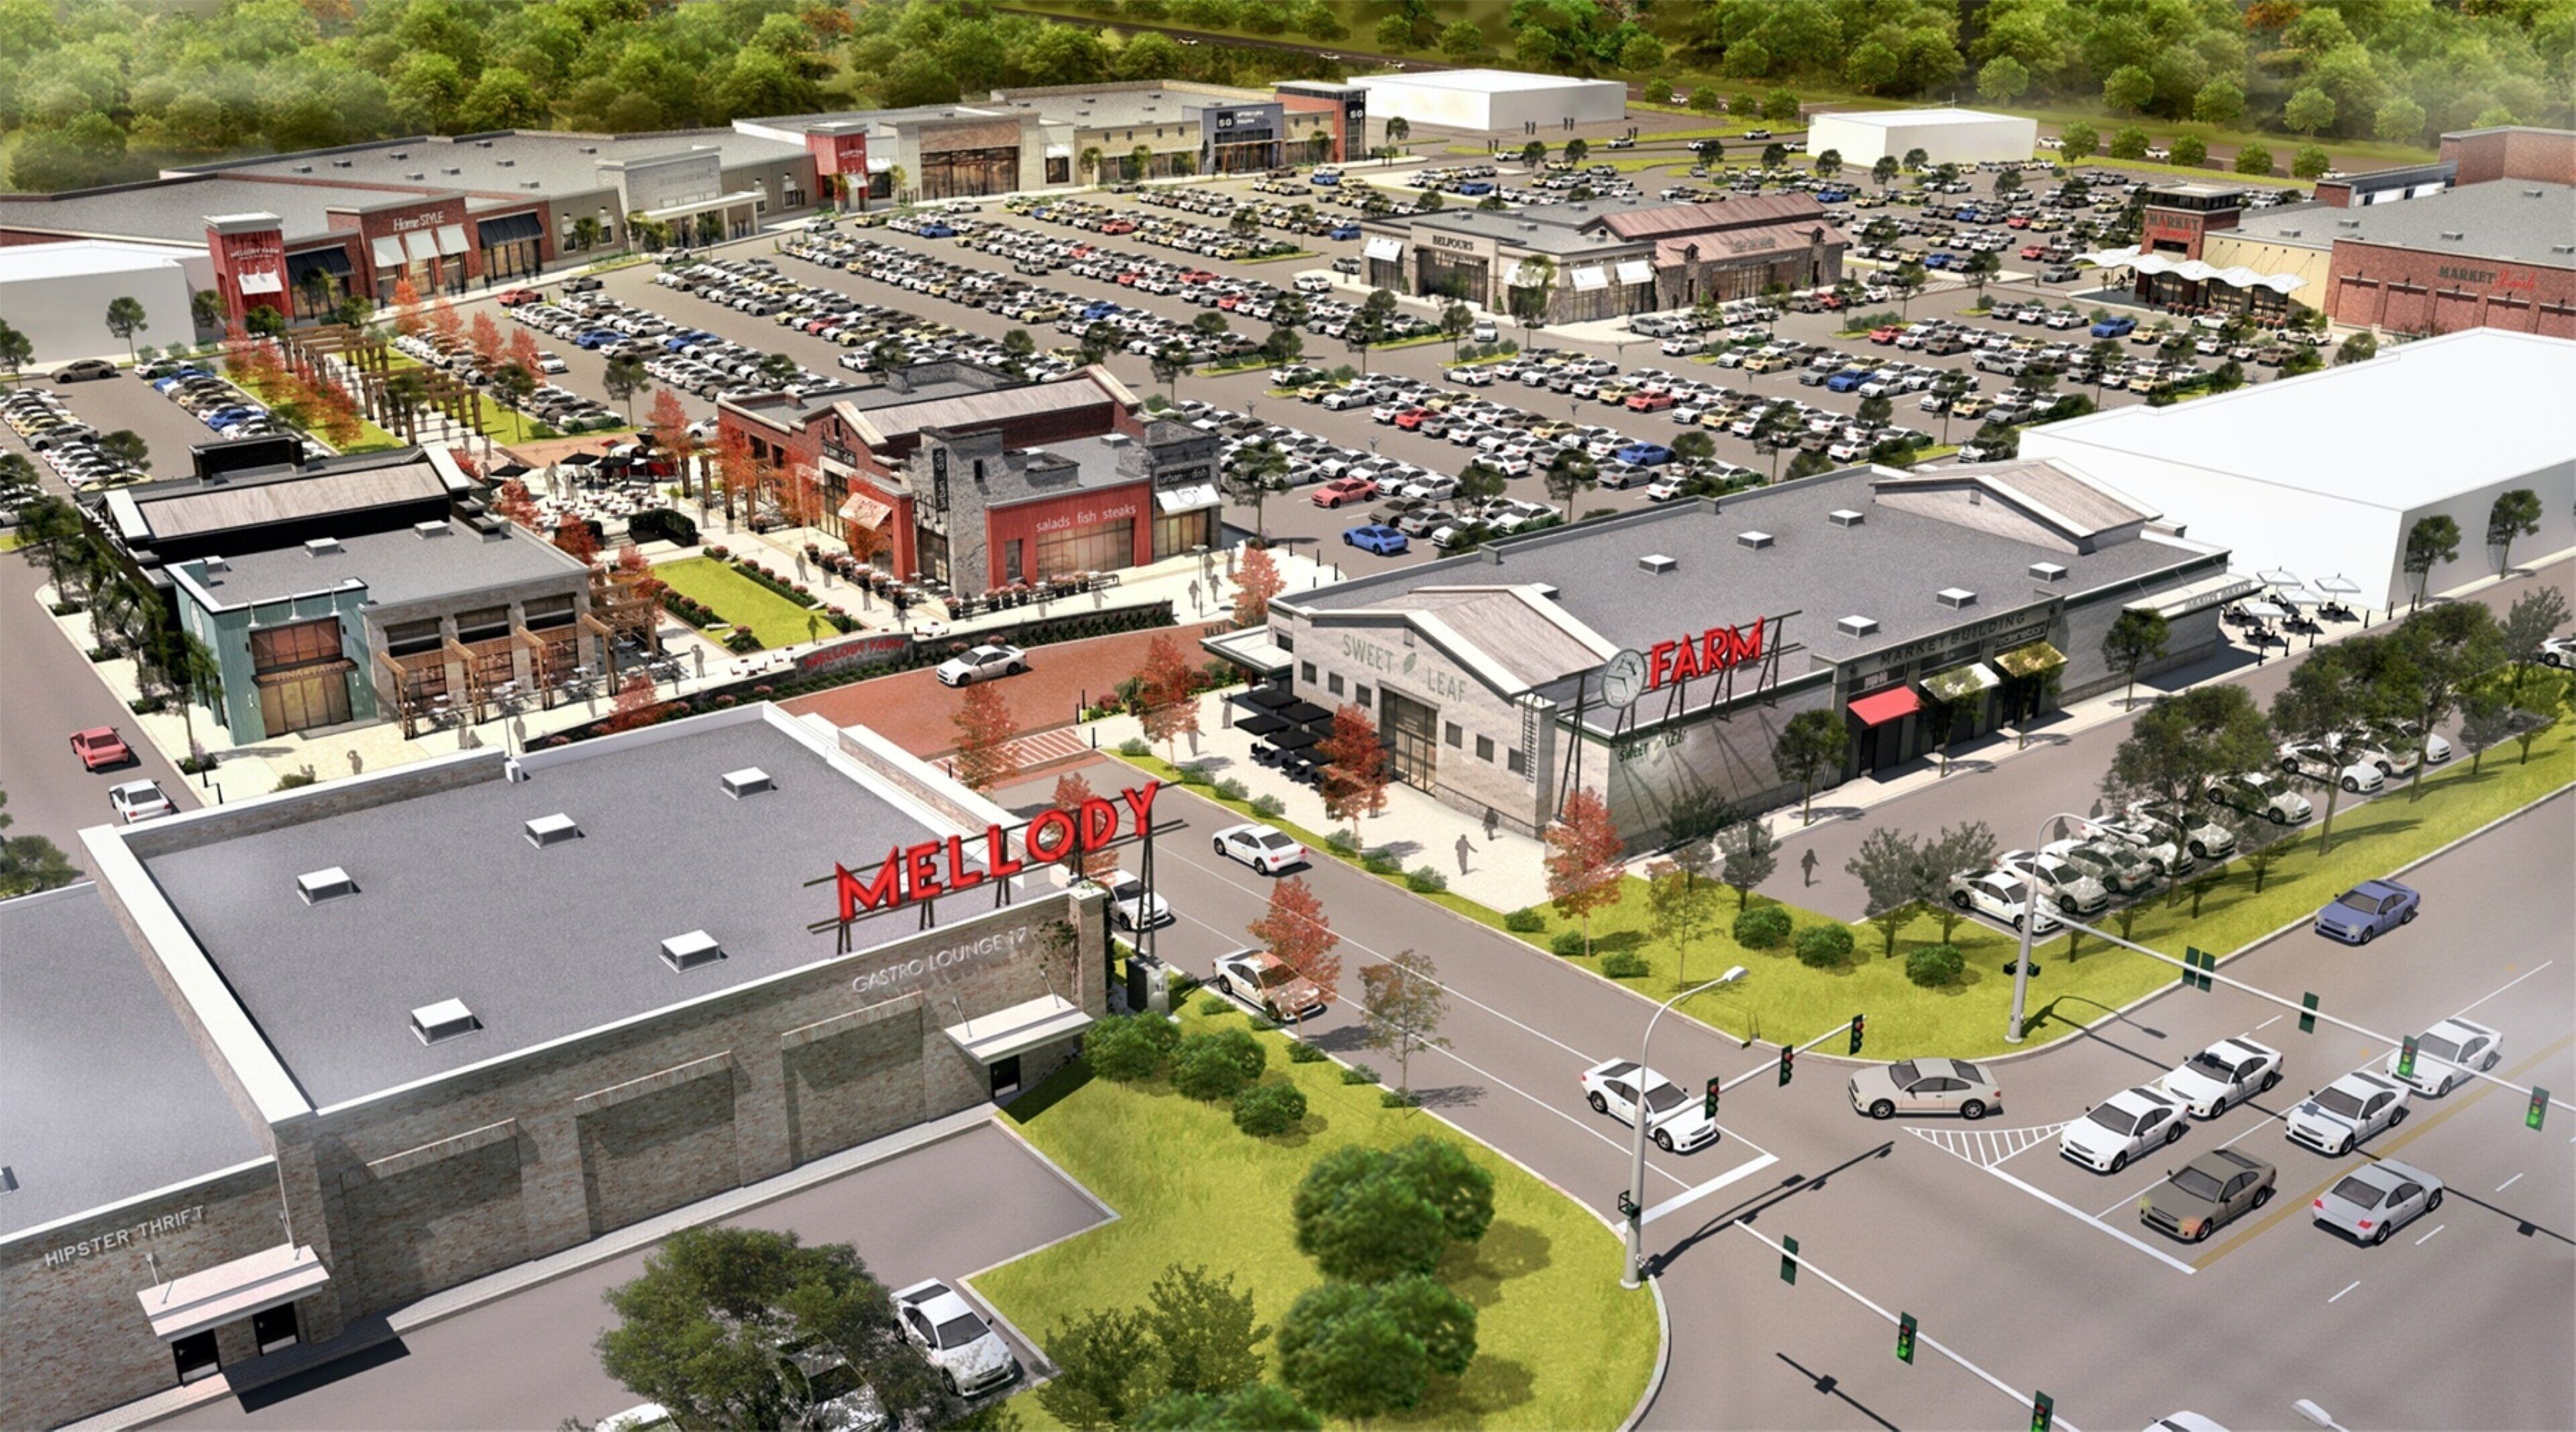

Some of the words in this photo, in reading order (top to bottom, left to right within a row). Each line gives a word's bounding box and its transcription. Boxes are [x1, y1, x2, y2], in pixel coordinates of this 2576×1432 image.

[1218, 117, 1232, 127] SG
[2438, 266, 2496, 284] MARKET
[1036, 516, 1071, 533] salads
[1077, 510, 1097, 524] fish
[1102, 504, 1136, 520] steaks
[1343, 634, 1393, 673] SWEET
[1427, 665, 1466, 702] LEAF
[1650, 615, 1764, 690] FARM
[1880, 640, 1945, 665] MARKET
[1951, 612, 2026, 644] BUILDING
[836, 781, 1159, 922] MELLODY
[853, 959, 924, 993] GASTRO
[929, 934, 1002, 971] LOUNGE
[1008, 926, 1027, 947] 17
[45, 1229, 129, 1266] HIPSTER
[137, 1205, 203, 1237] THRIFT
